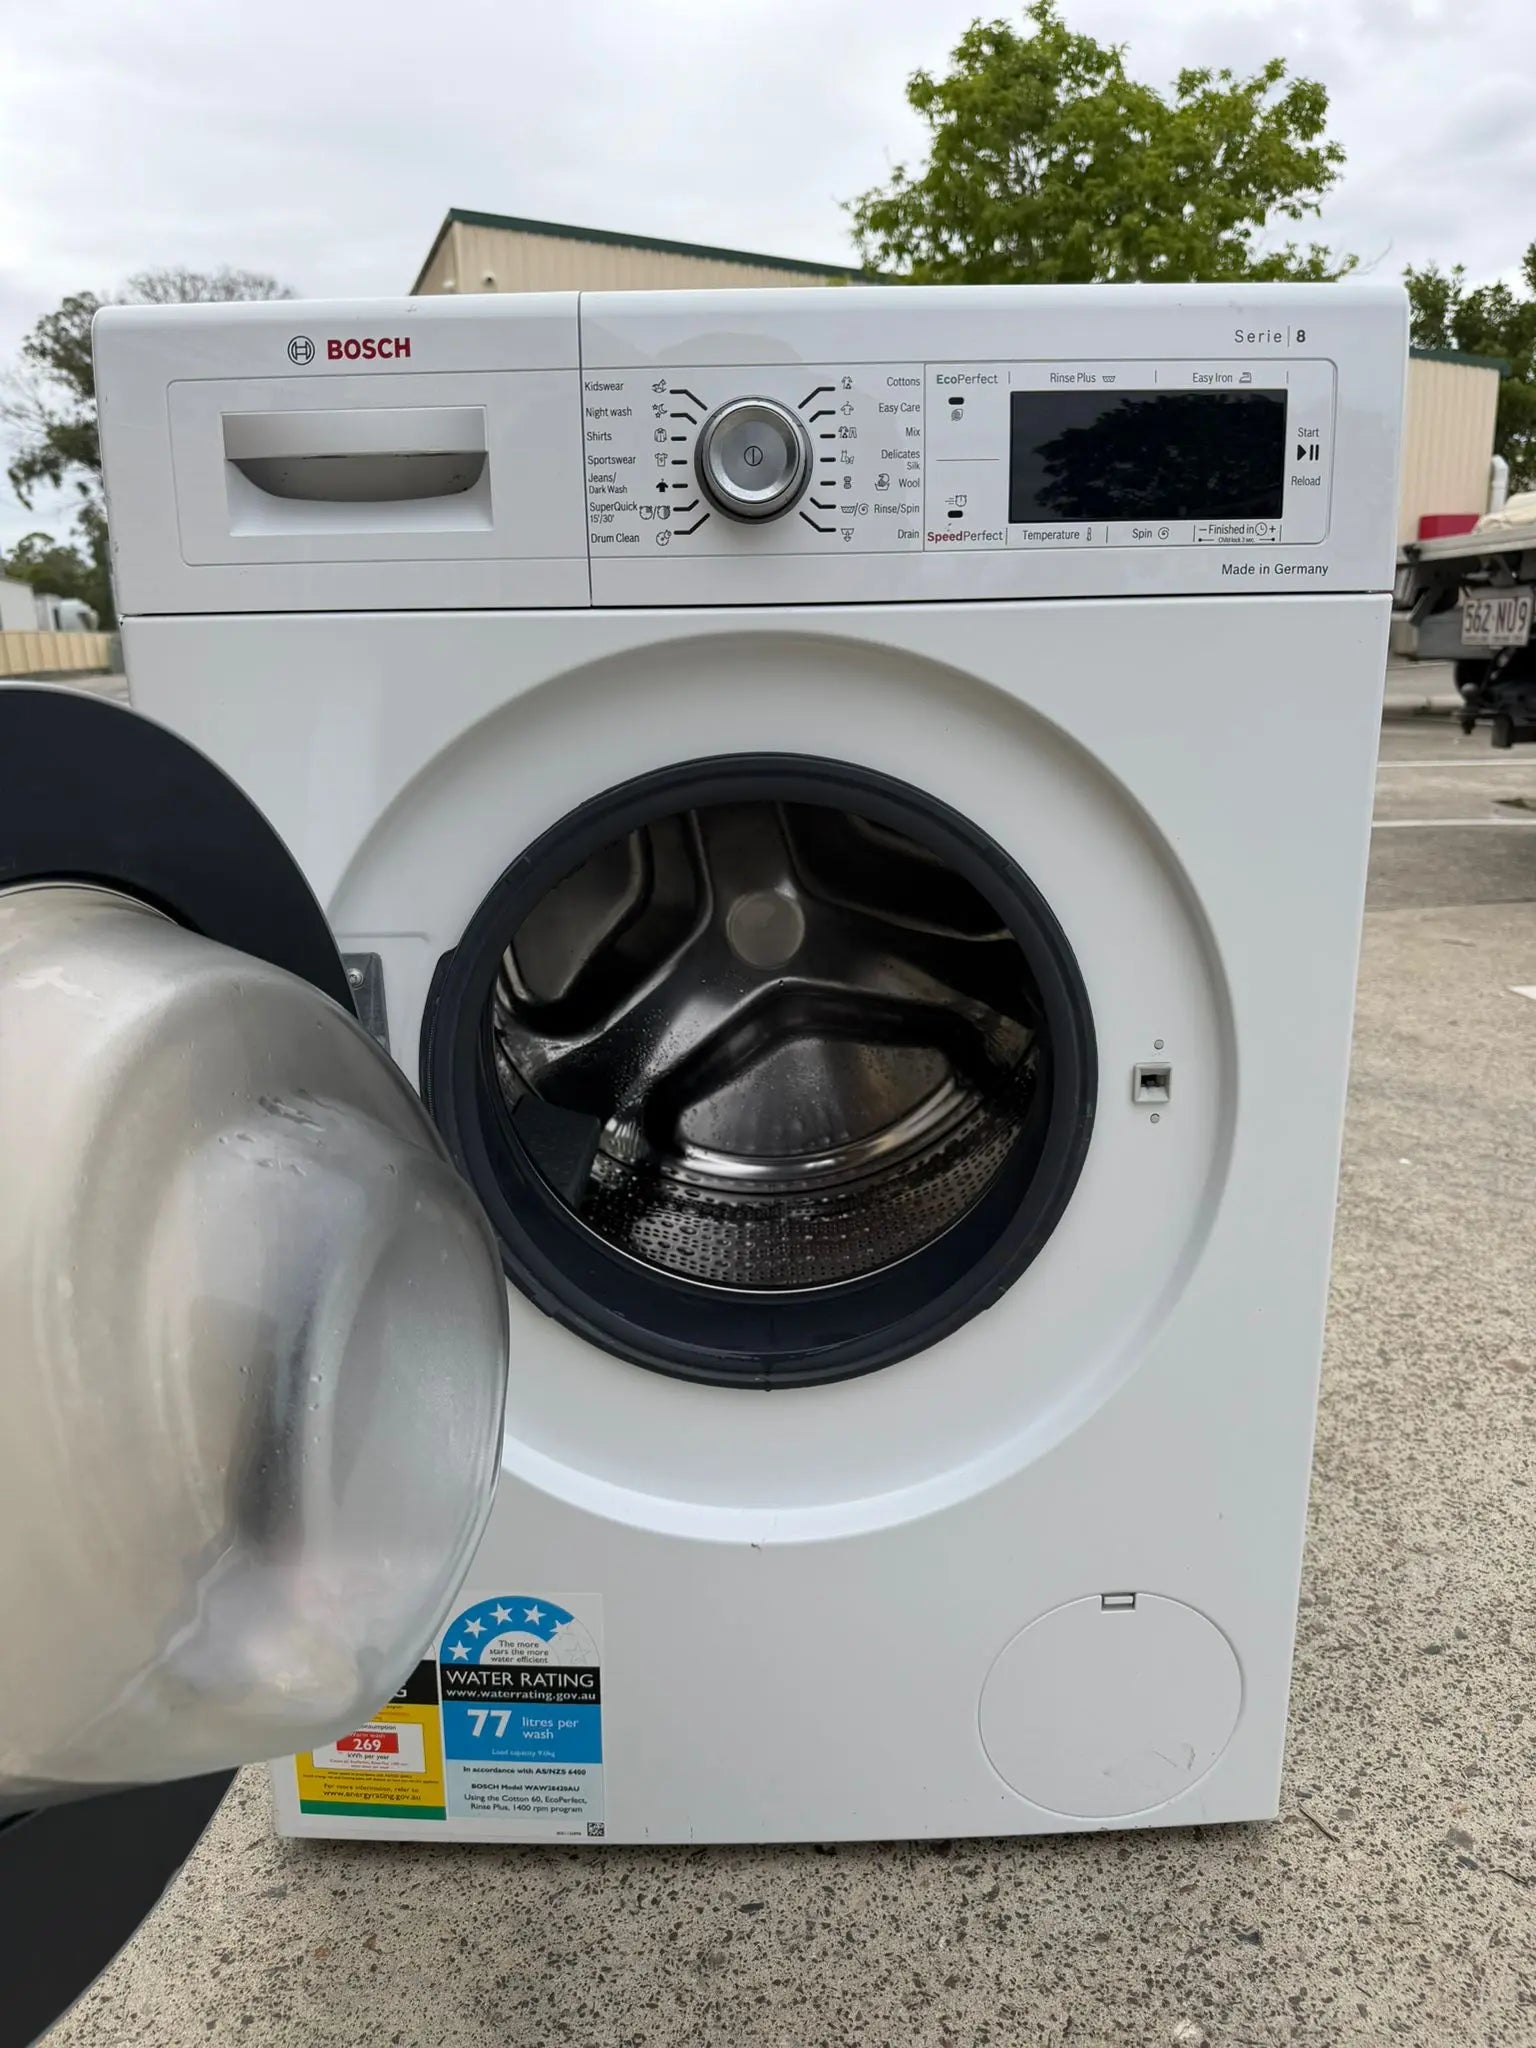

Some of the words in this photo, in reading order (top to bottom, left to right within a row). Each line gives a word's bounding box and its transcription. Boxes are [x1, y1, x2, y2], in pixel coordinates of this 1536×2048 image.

[1234, 330, 1282, 343] Serie
[1296, 330, 1306, 342] 8
[327, 337, 411, 360] BOSCH
[886, 376, 920, 387] Cottons
[936, 374, 998, 384] EcoPerfect
[1050, 372, 1075, 383] Rinse
[1077, 372, 1096, 383] Plus
[1192, 372, 1214, 385] Easy
[1216, 372, 1232, 383] Iron
[584, 382, 624, 392] Kidswear
[586, 408, 608, 419] Night
[612, 406, 632, 417] wash
[878, 403, 898, 414] Easy
[900, 402, 920, 412] Care
[586, 432, 612, 441] Shirts
[906, 427, 920, 437] Mix
[1298, 427, 1320, 438] Start
[588, 455, 636, 466] Sportswear
[881, 450, 920, 460] Delicates
[906, 462, 920, 470] Silk
[588, 472, 616, 484] Jeans/
[898, 478, 920, 488] Wool
[1292, 476, 1320, 486] Reload
[589, 486, 606, 494] Dark
[608, 485, 628, 494] Wash
[590, 501, 638, 513] SuperQuick
[874, 503, 920, 514] Rinse/Spin
[898, 529, 920, 539] Drain
[1132, 528, 1152, 540] Spin
[1208, 524, 1245, 534] Finished
[1246, 524, 1254, 534] in
[591, 533, 614, 544] Drum
[616, 532, 640, 542] Clean
[928, 530, 1003, 544] SpeedPerfect
[1022, 530, 1080, 542] Temperature
[1222, 564, 1256, 574] Made
[1260, 564, 1270, 574] in
[1274, 564, 1328, 576] Germany
[1465, 602, 1491, 633] 562
[498, 1640, 514, 1648] The
[446, 1670, 514, 1686] WATER
[520, 1672, 594, 1688] RATING
[446, 1689, 596, 1702] www.waterrating.gov.au
[467, 1709, 512, 1738] 77
[522, 1716, 554, 1728] litres
[558, 1718, 579, 1730] per
[522, 1730, 554, 1740] wash
[352, 1738, 382, 1751] 269
[472, 1766, 515, 1774] accordance
[323, 1790, 421, 1800] www.energyrating.gov.au
[464, 1794, 486, 1803] Using
[471, 1803, 492, 1811] Rinse
[513, 1804, 531, 1812] 1400
[550, 1806, 583, 1814] program
